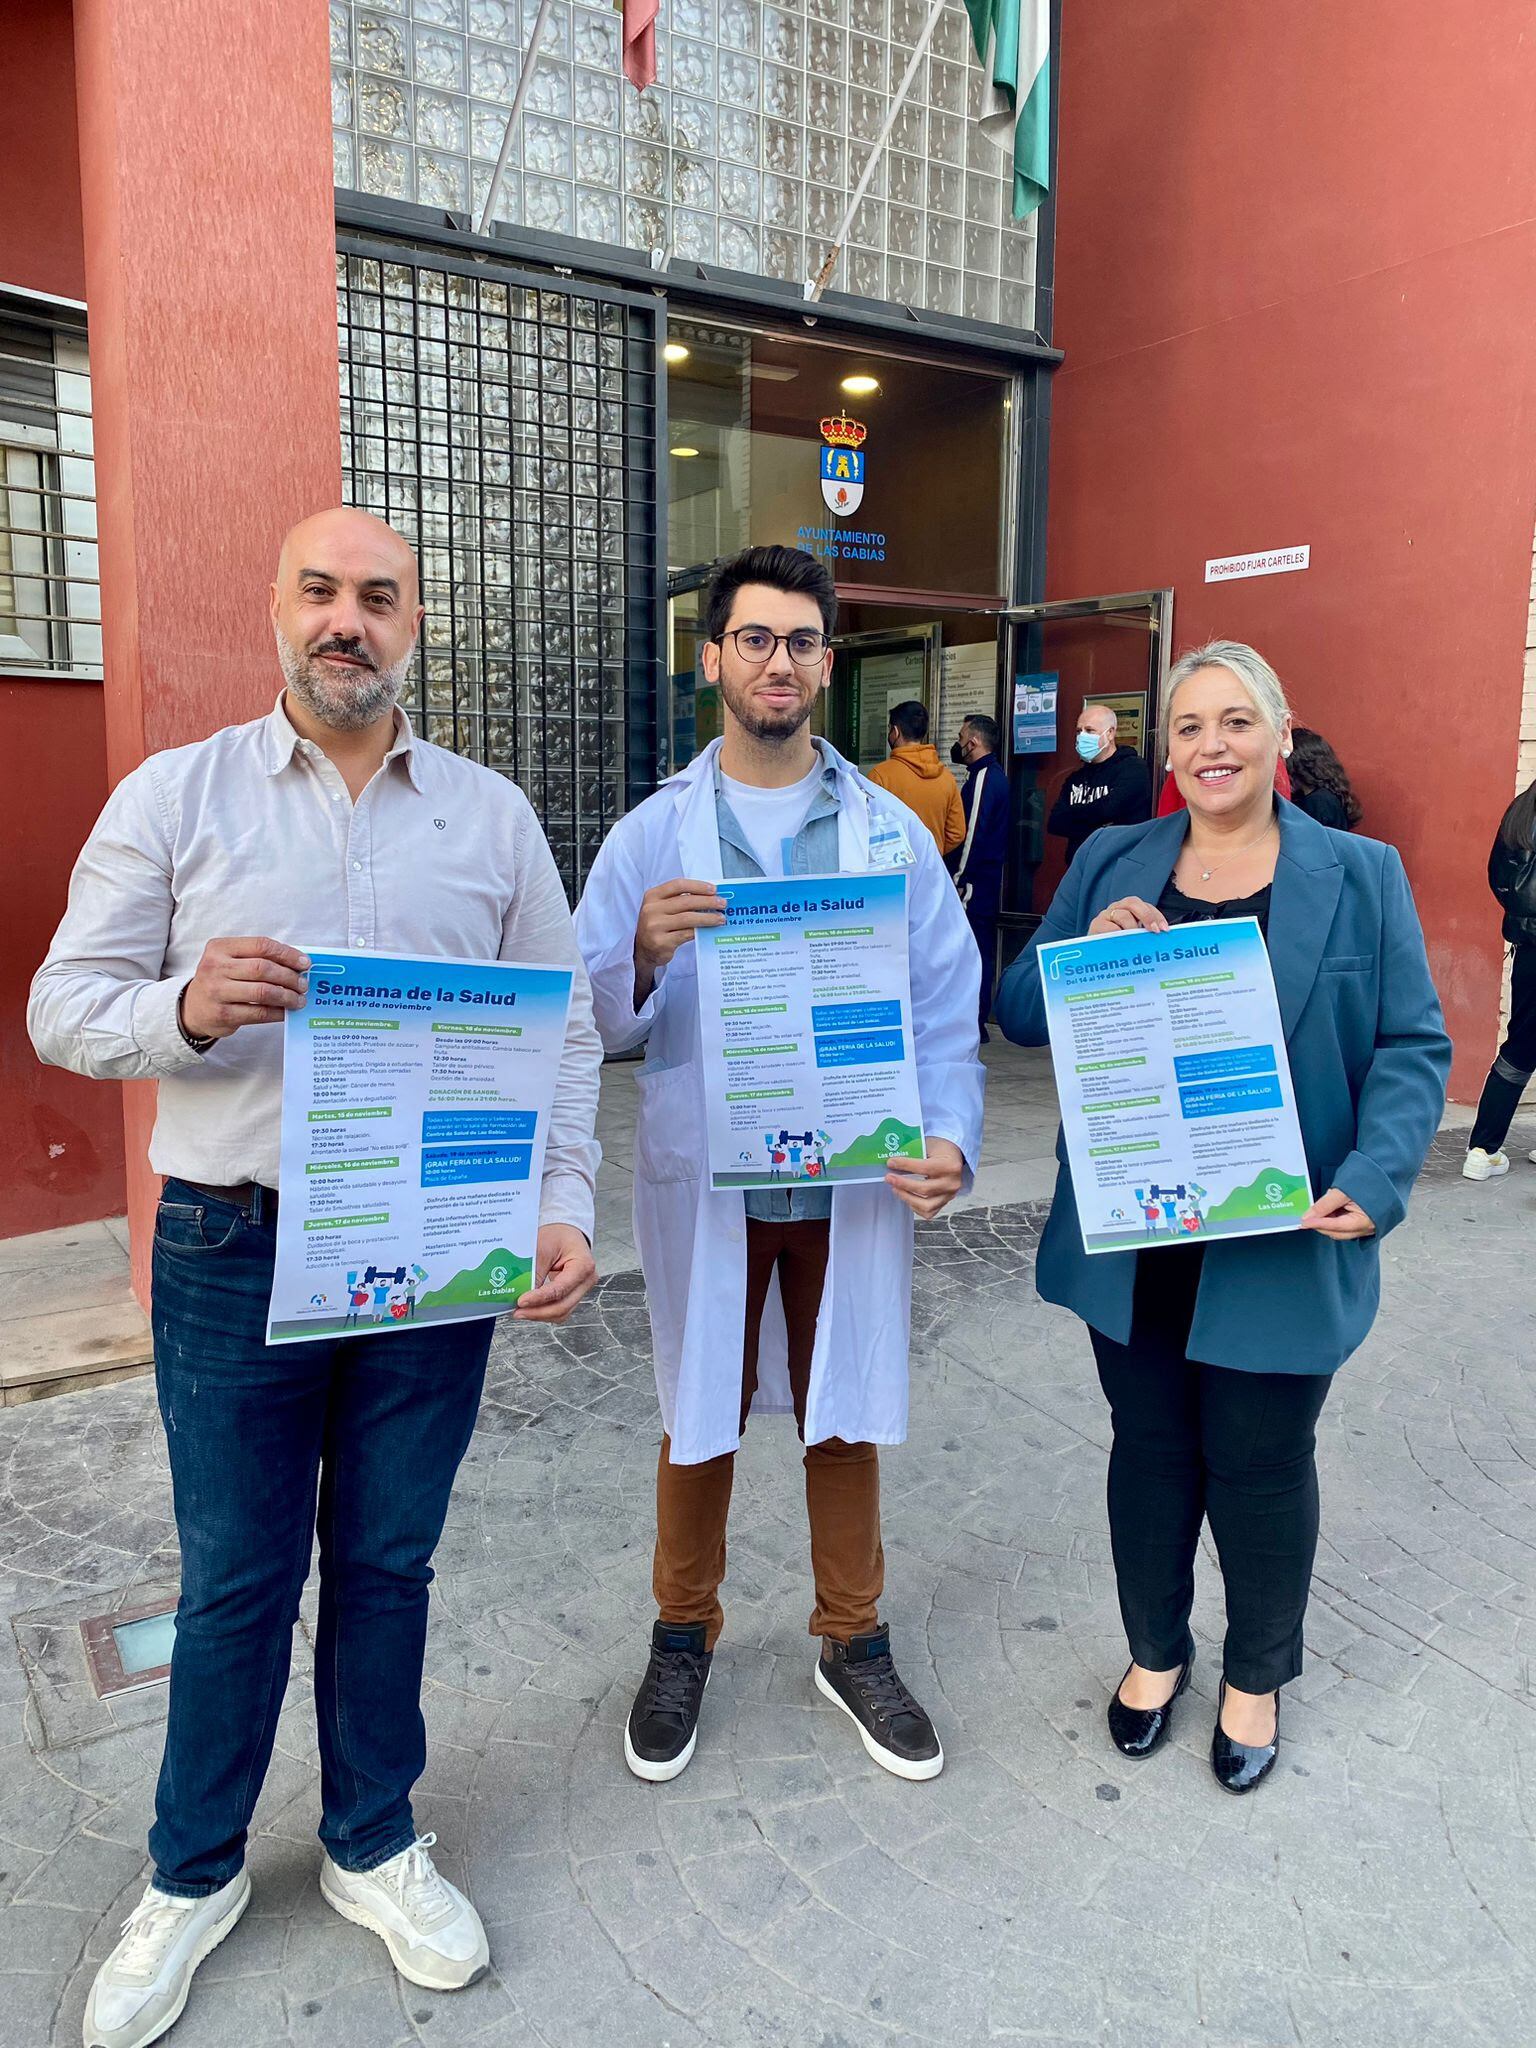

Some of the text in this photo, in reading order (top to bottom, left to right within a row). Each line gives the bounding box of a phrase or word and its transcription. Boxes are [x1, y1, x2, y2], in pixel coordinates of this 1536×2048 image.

[797, 526, 885, 545] AYUNTAMIENTO
[817, 545, 839, 557] LAS
[842, 547, 885, 561] GABIAS
[1210, 553, 1304, 575] PROHIBIDO FIJAR CARTELES
[782, 901, 800, 912] de
[804, 900, 817, 911] la
[821, 897, 865, 911] Salud
[1064, 944, 1220, 976] Semana de la Salud
[1116, 967, 1155, 978] noviembre
[316, 980, 516, 1006] Semana de la Salud
[426, 1160, 448, 1169] ¡GRAN
[424, 1202, 451, 1210] promoción
